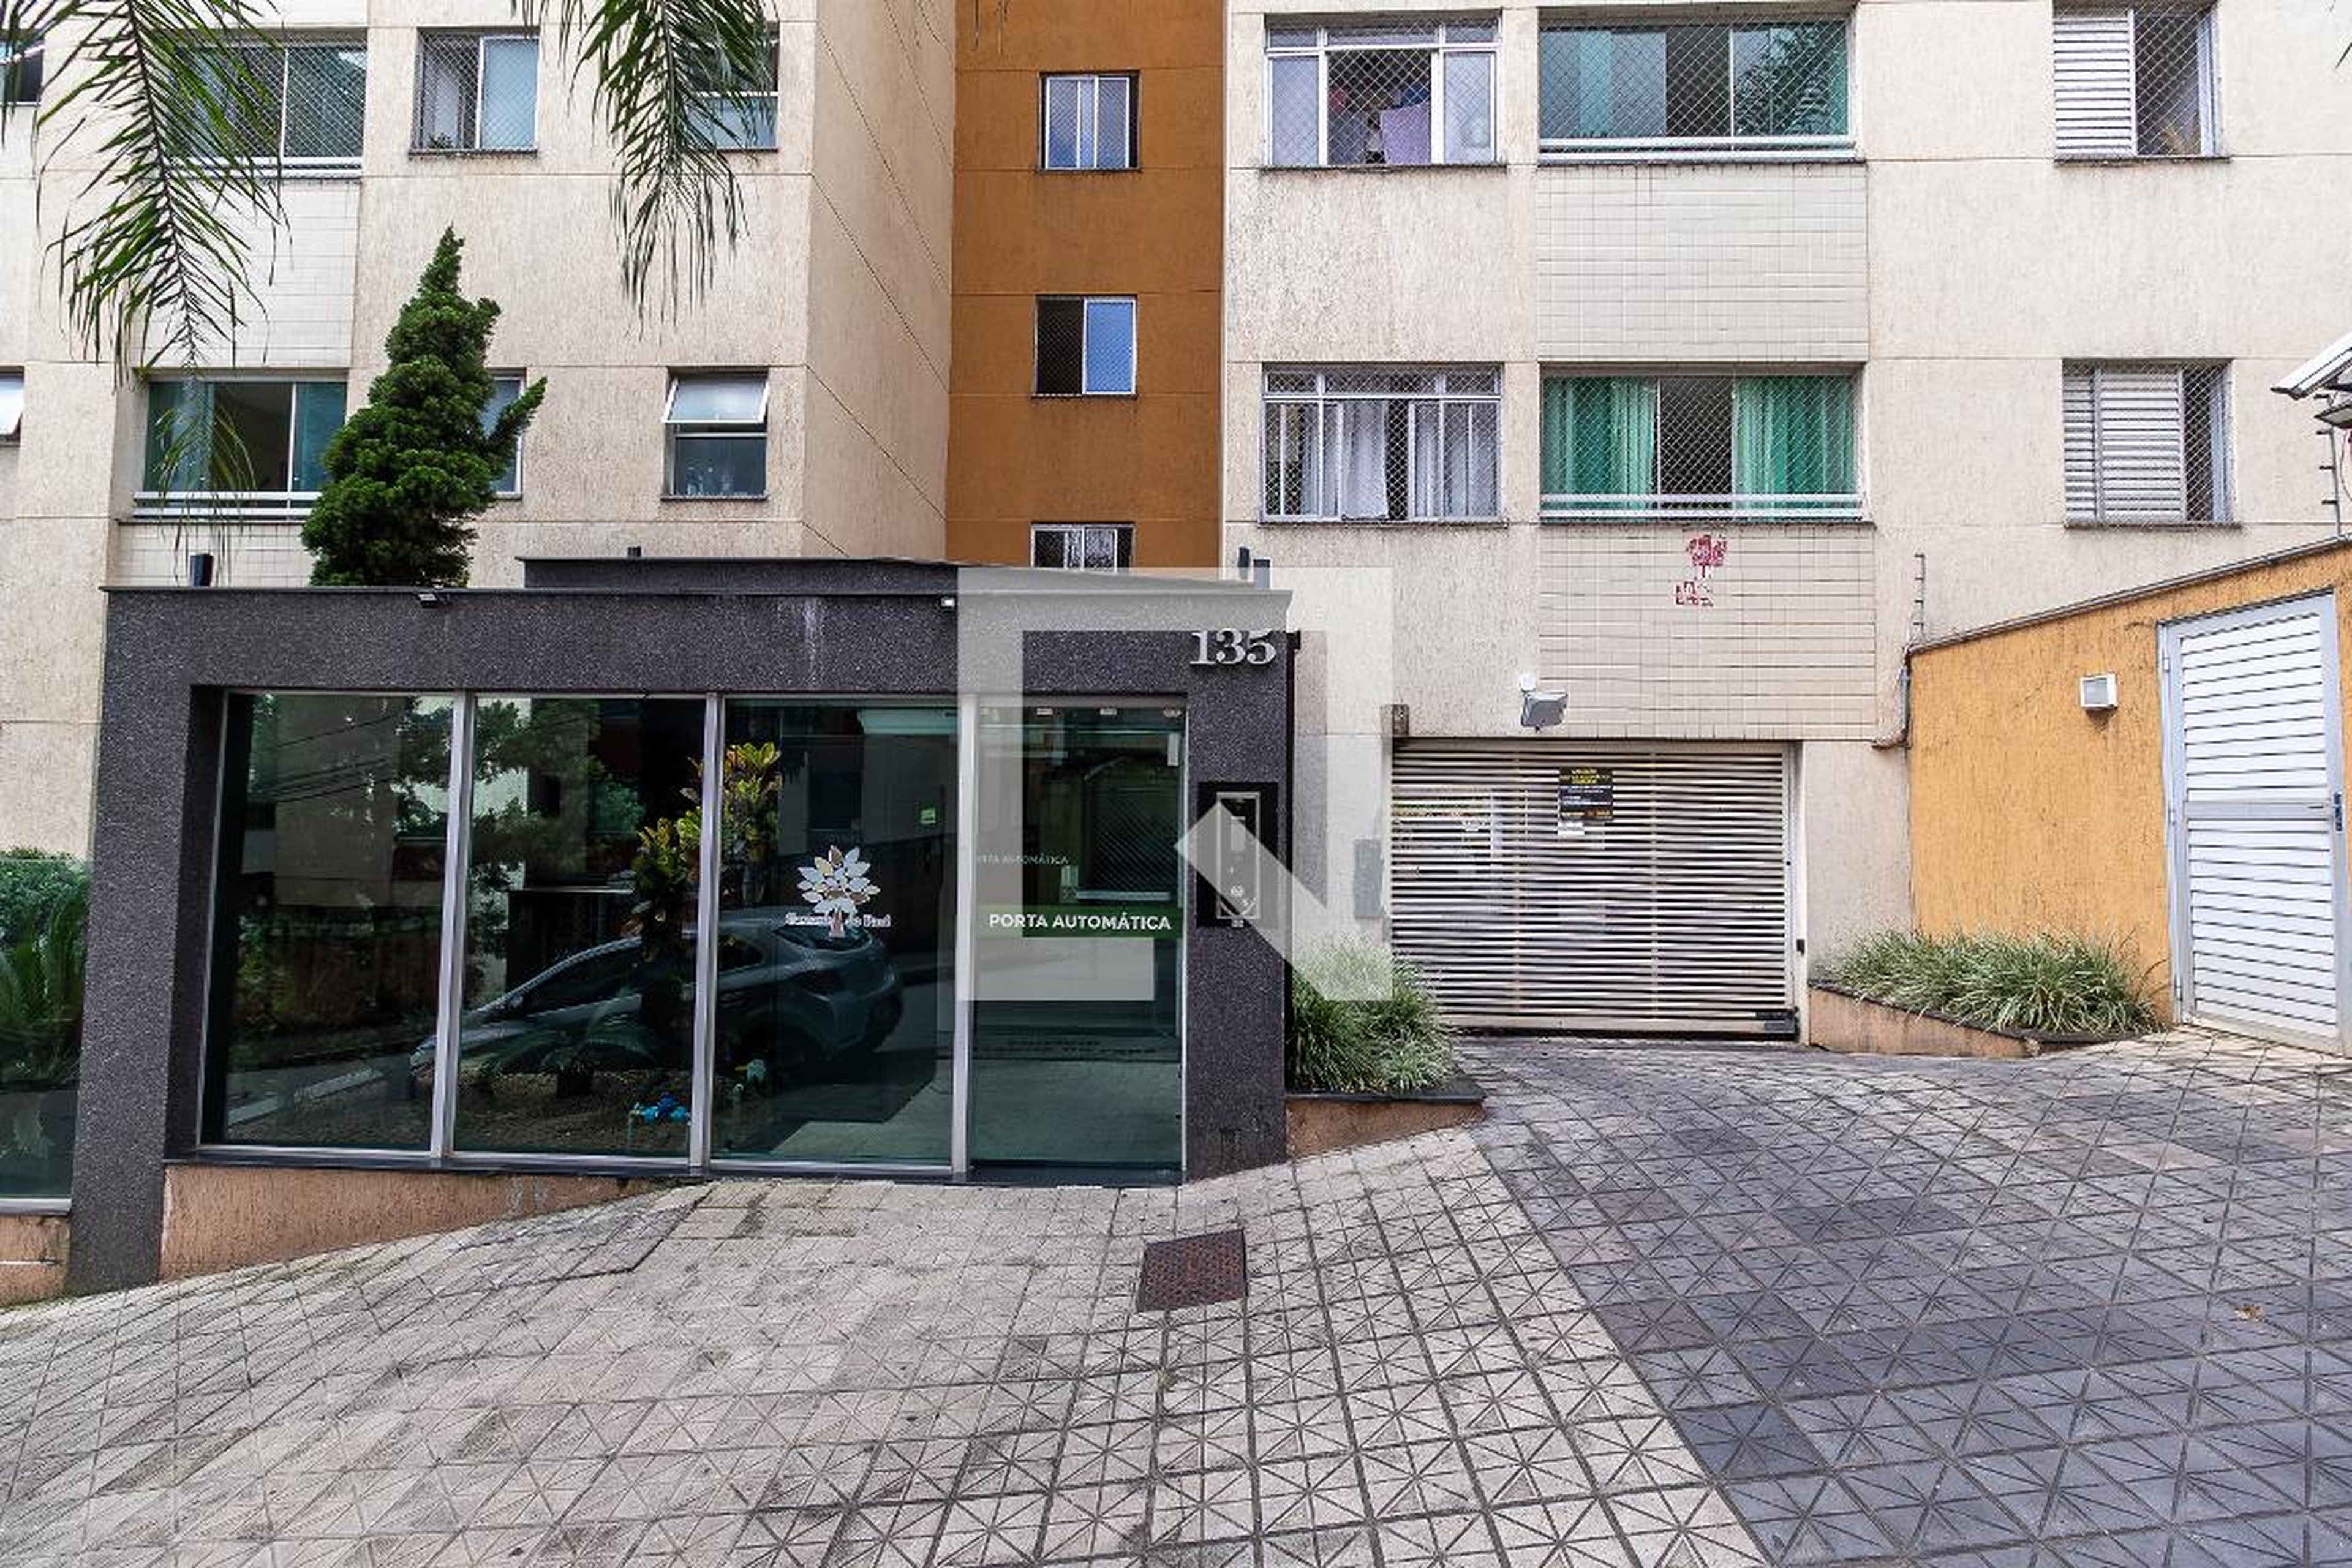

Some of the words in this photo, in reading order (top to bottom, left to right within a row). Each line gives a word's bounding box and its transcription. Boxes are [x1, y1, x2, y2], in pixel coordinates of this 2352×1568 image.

[1189, 628, 1276, 665] 135
[989, 914, 1049, 928] PORTA
[1052, 912, 1172, 930] AUTOMÁTICA
